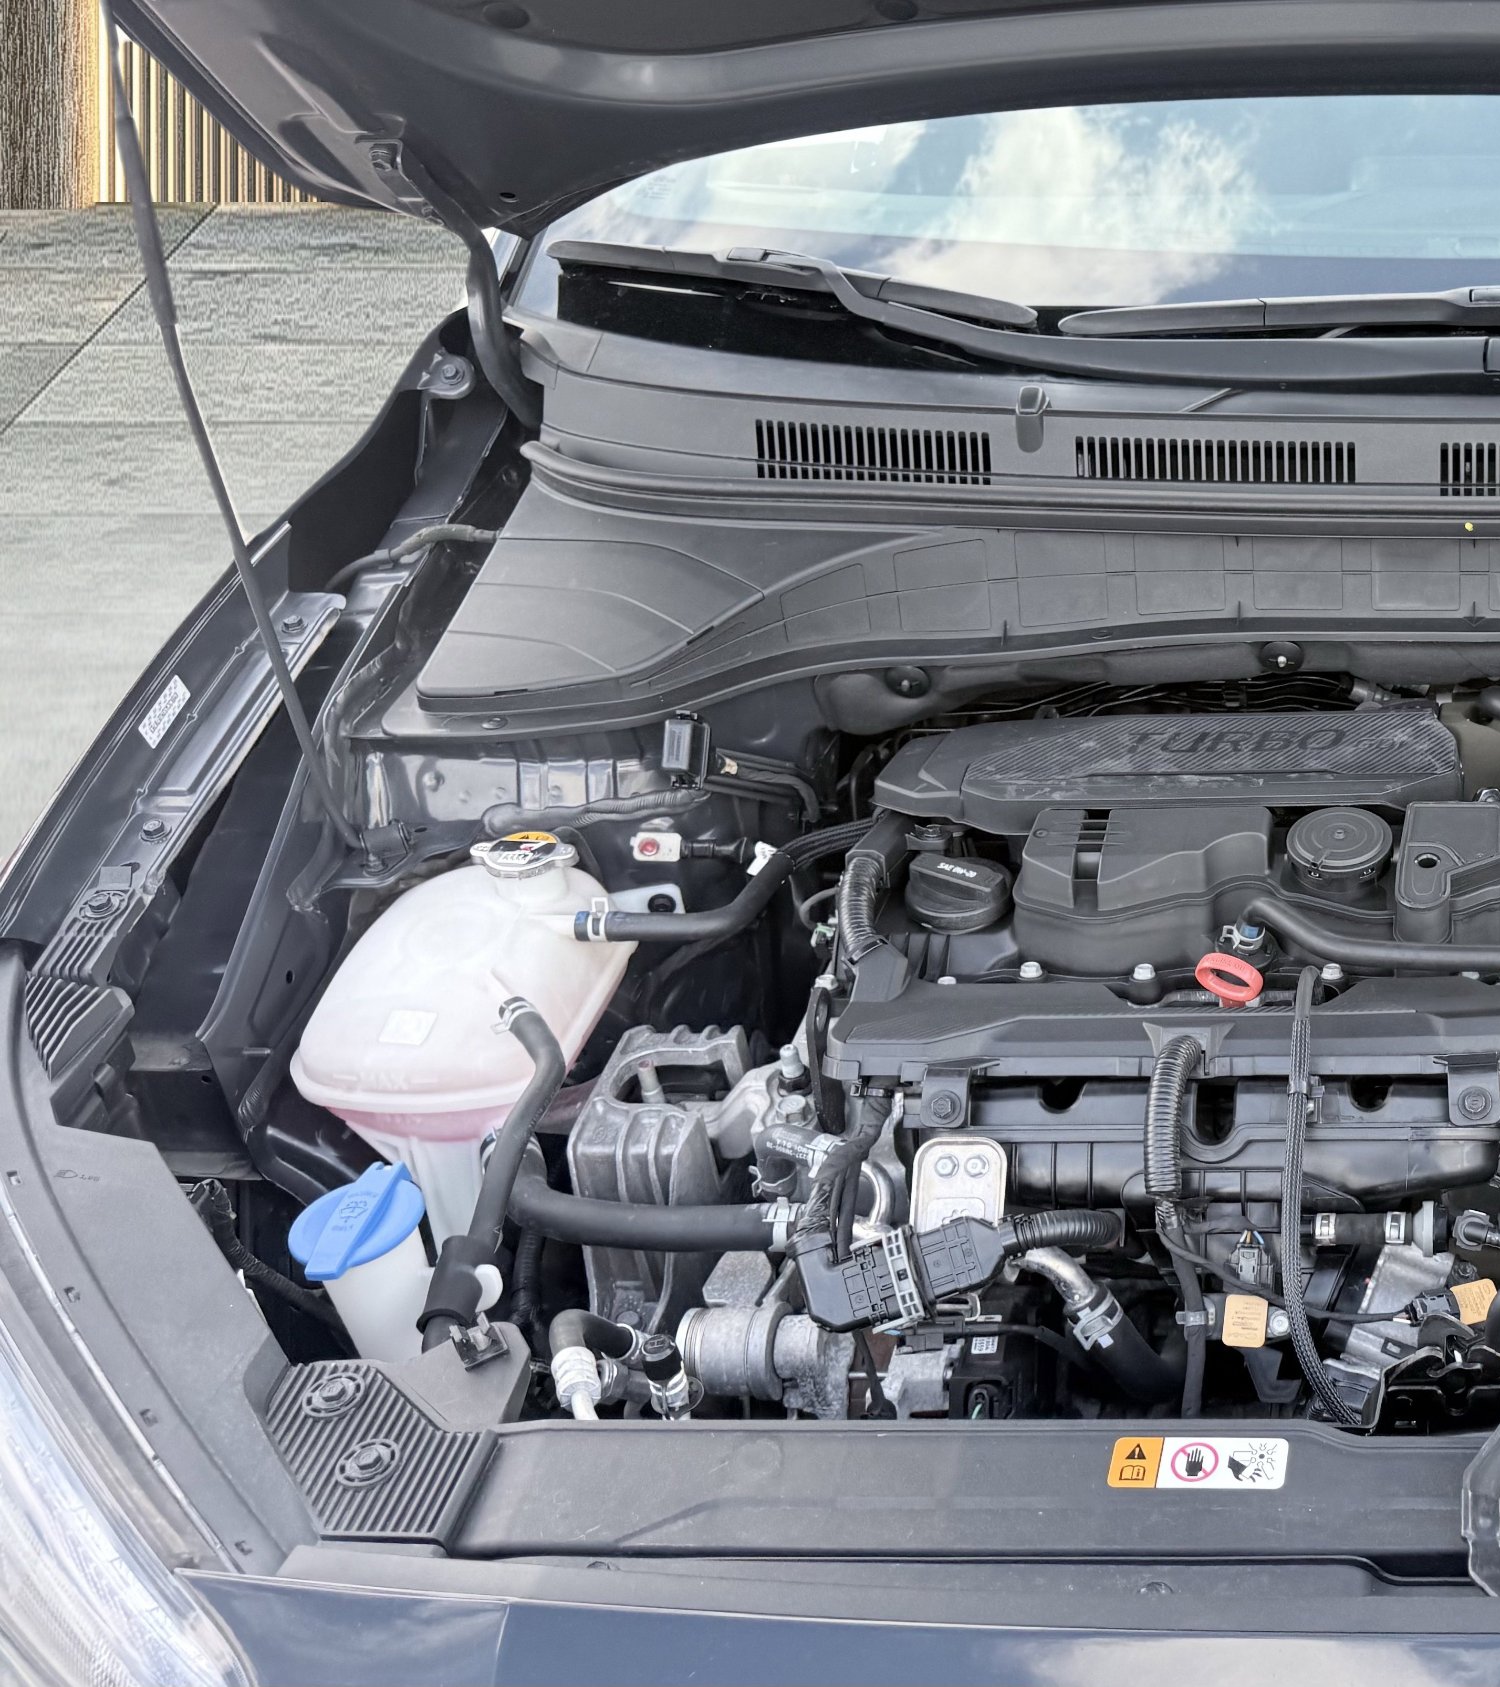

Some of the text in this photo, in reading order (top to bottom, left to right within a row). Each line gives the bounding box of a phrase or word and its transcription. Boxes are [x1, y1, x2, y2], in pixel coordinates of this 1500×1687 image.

[1128, 729, 1348, 753] TURBO
[937, 862, 955, 871] SAE
[358, 1071, 408, 1091] MAX
